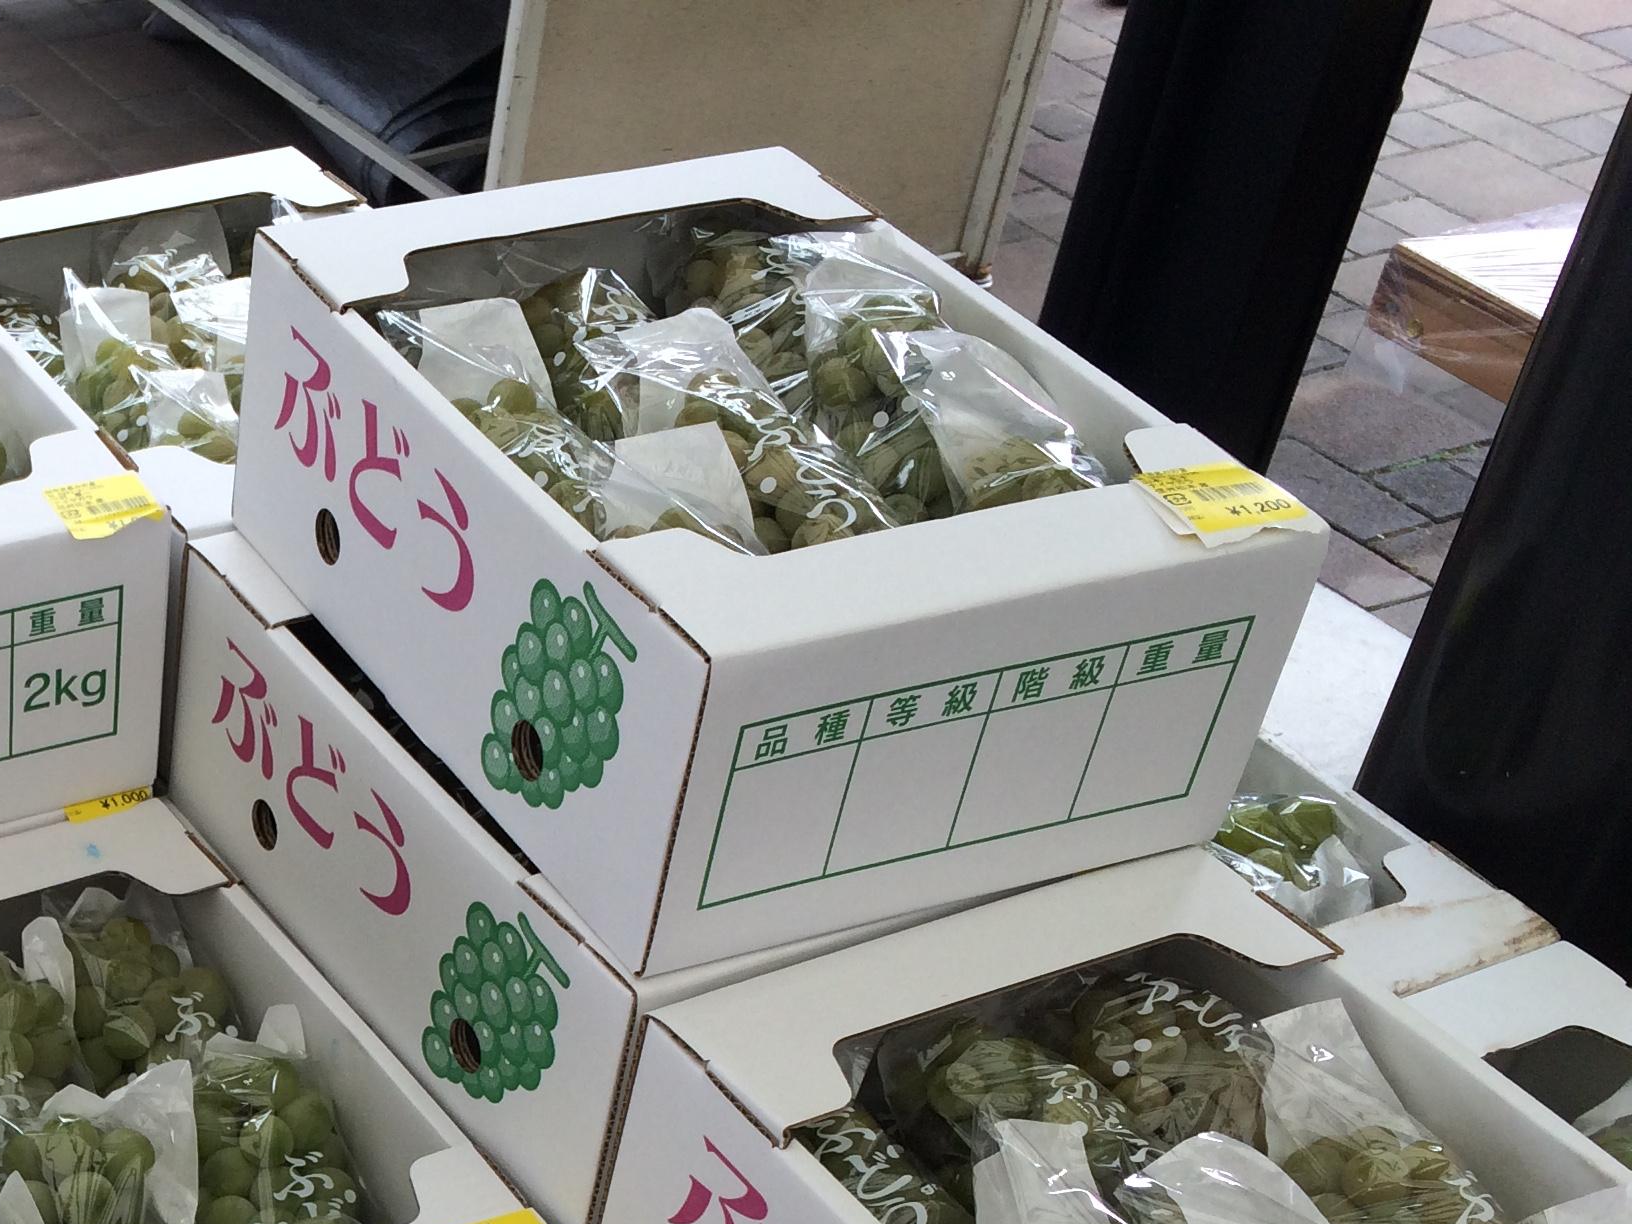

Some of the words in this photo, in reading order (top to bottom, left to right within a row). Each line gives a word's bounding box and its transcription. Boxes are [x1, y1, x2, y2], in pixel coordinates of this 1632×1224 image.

[275, 325, 476, 613] ぶどう
[1225, 498, 1291, 517] ¥1,200
[29, 597, 105, 637] 重量
[1141, 631, 1230, 677] 重量
[22, 667, 108, 715] 2kg
[1011, 658, 1105, 702] 階級
[886, 684, 978, 728] 等級
[755, 709, 851, 760] 品種
[211, 638, 412, 915] ぶどう
